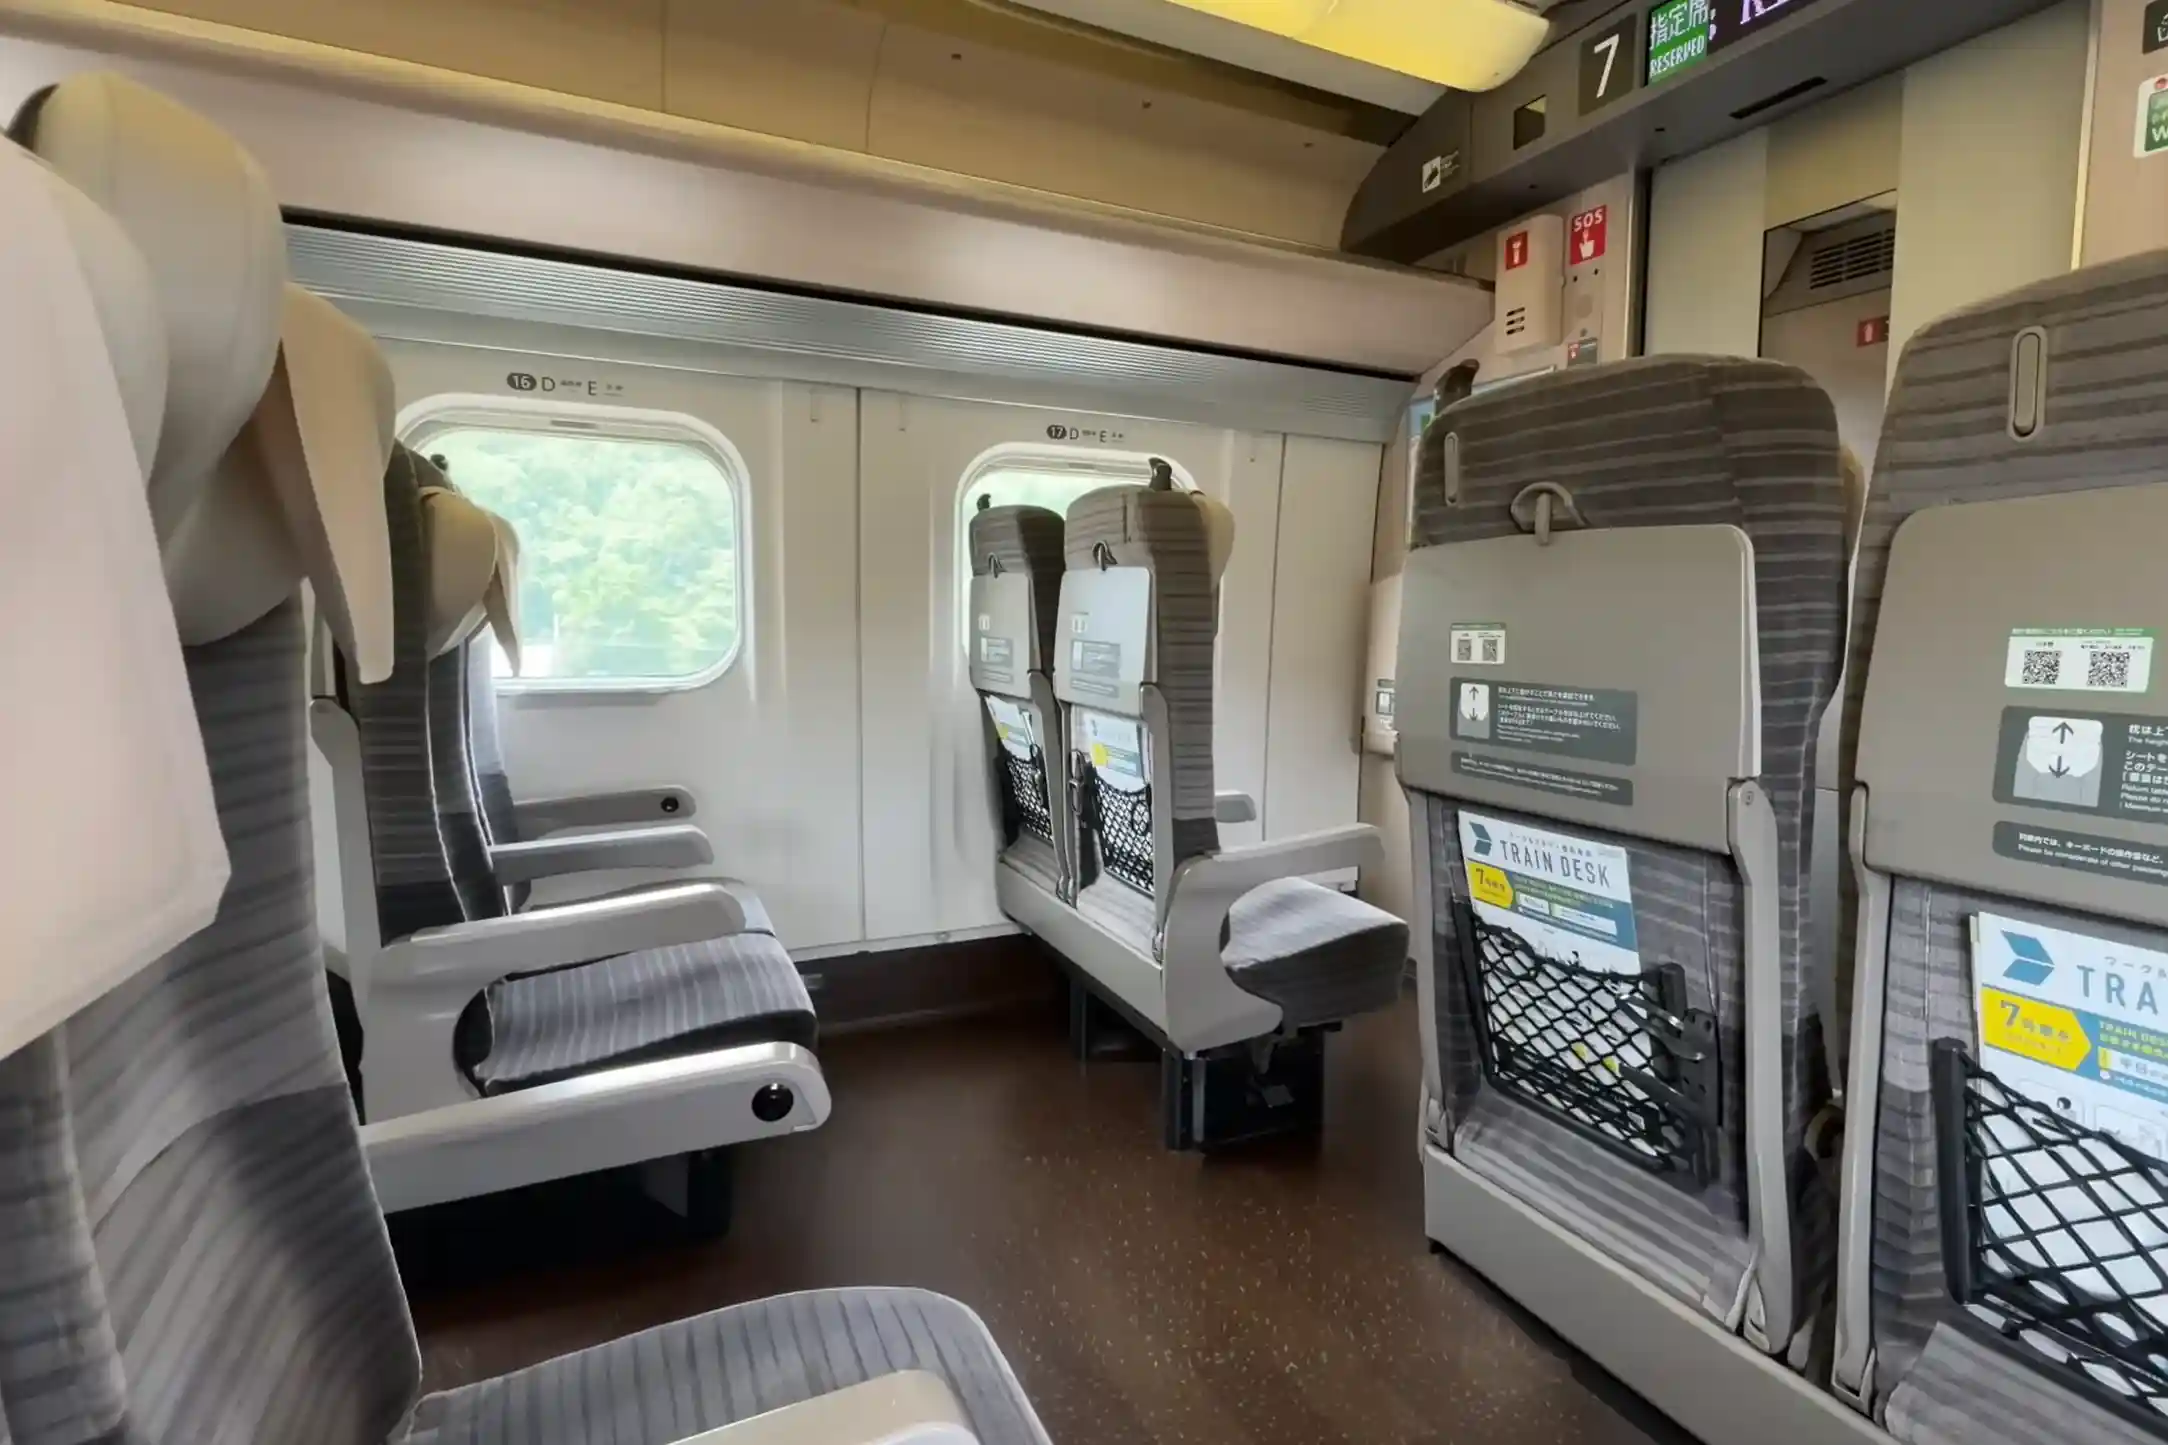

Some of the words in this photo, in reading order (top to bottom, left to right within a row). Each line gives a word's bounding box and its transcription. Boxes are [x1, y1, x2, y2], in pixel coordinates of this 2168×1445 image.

[1650, 0, 1710, 49] 指定席
[1593, 33, 1620, 98] 7
[1650, 35, 1705, 77] RESERVED
[1574, 208, 1604, 232] SOS
[541, 376, 555, 392] D
[588, 381, 597, 396] E
[1070, 428, 1079, 440] D
[1100, 430, 1107, 442] E
[1500, 839, 1554, 874] TRAIN
[1560, 856, 1611, 889] DESK
[2077, 964, 2159, 1016] TRA
